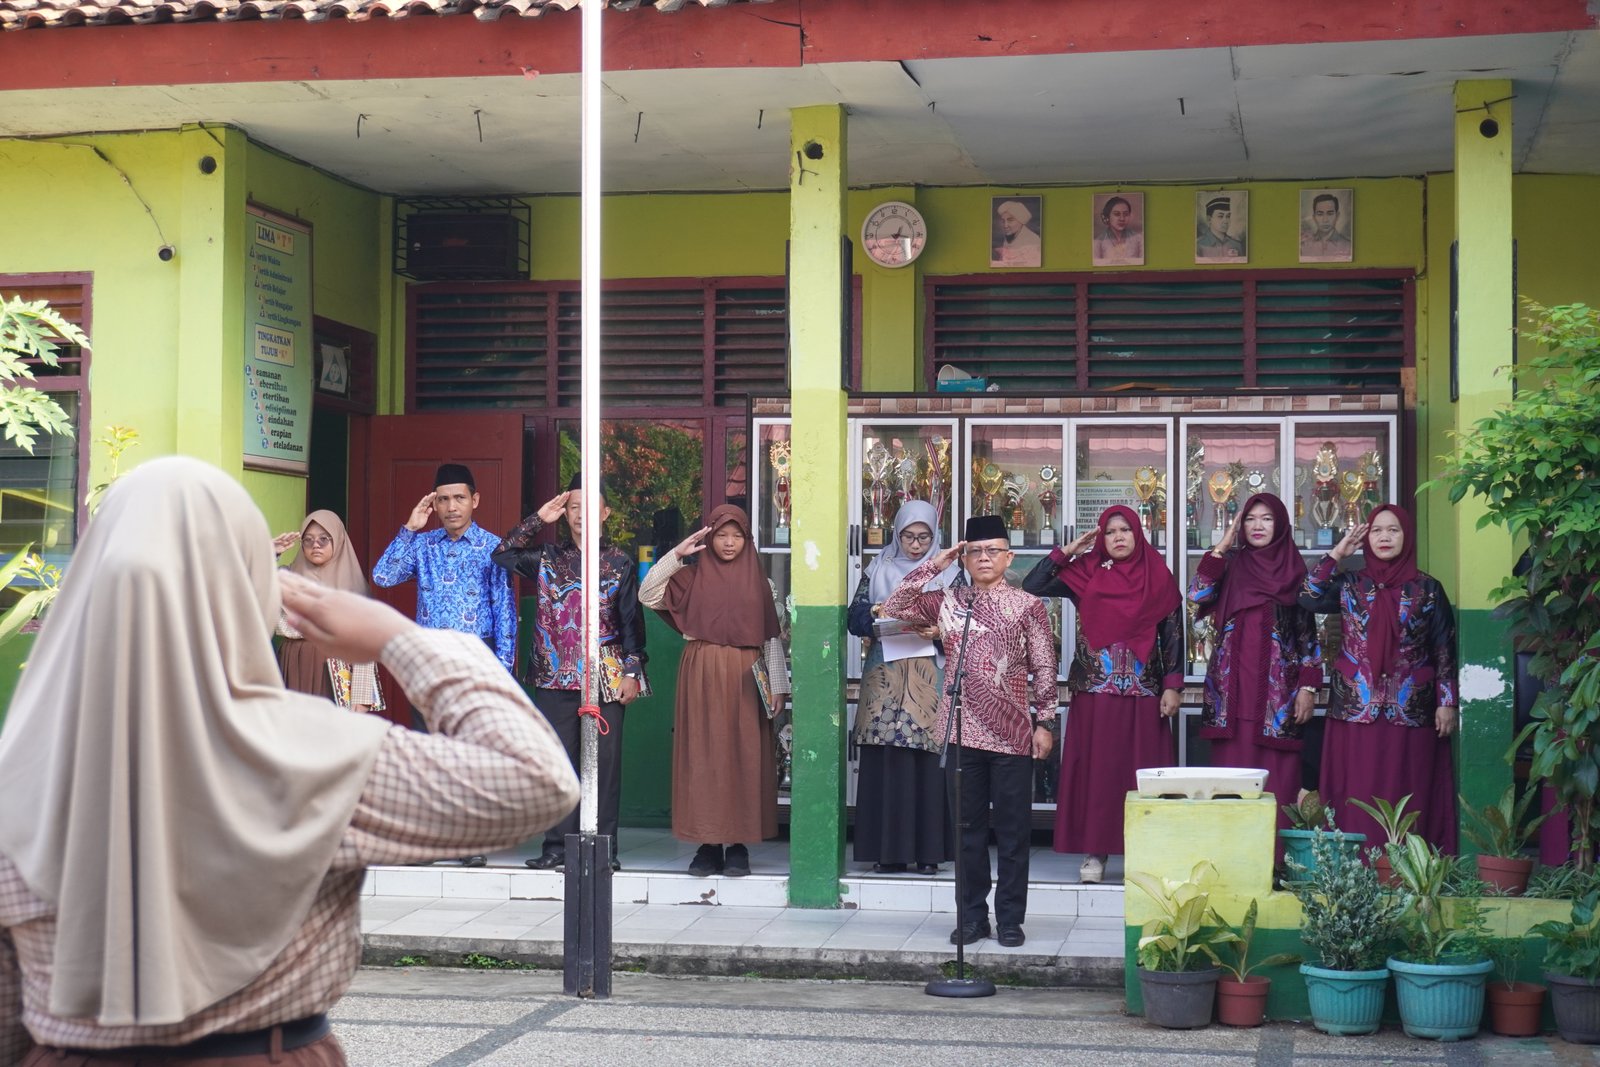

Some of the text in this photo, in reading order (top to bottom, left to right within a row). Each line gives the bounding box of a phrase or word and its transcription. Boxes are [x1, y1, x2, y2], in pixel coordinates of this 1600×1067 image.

[257, 225, 276, 244] LIMA
[257, 330, 292, 347] TINGKATKAN
[260, 345, 279, 357] TUJUH
